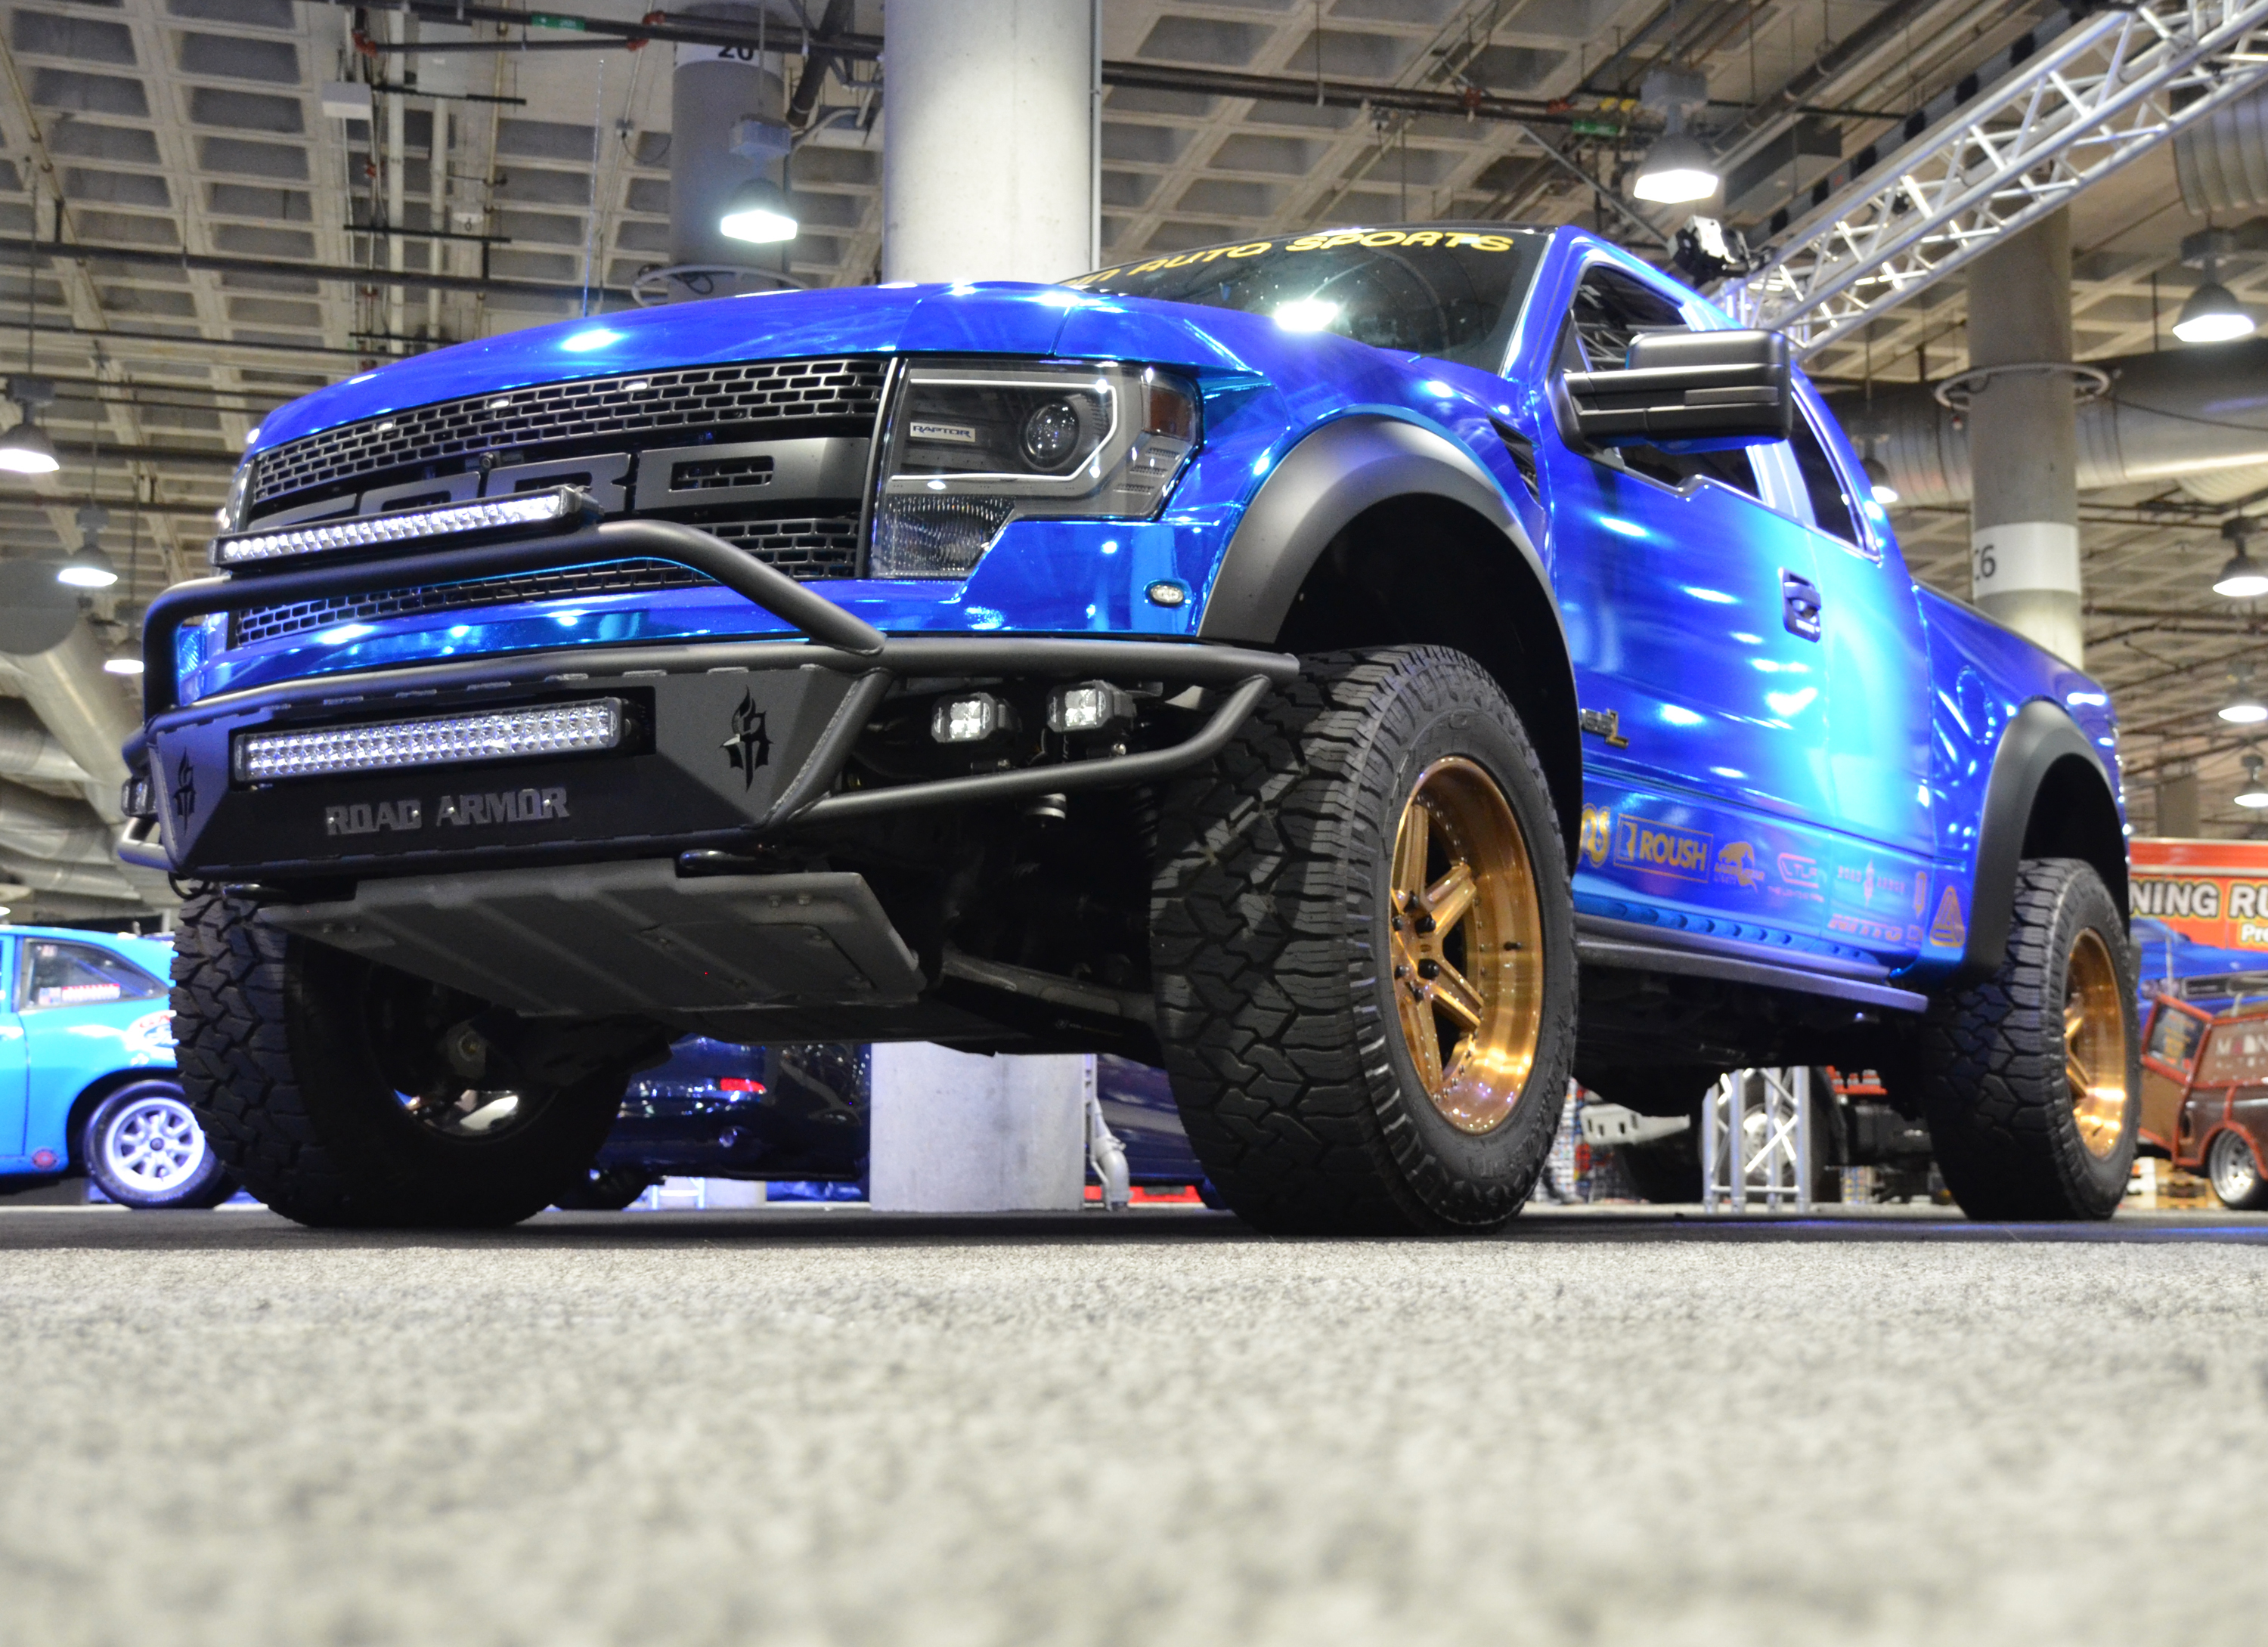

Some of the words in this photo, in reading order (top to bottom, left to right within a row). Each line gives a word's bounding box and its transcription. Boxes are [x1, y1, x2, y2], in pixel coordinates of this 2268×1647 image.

[1126, 242, 1272, 276] AUTO
[1285, 231, 1514, 252] SPORTS
[912, 425, 972, 438] RAPTOR
[325, 799, 422, 836] ROAD
[435, 787, 571, 828] ARMOR
[1639, 829, 1708, 871] ROUSH
[1827, 913, 1904, 943] NITTO
